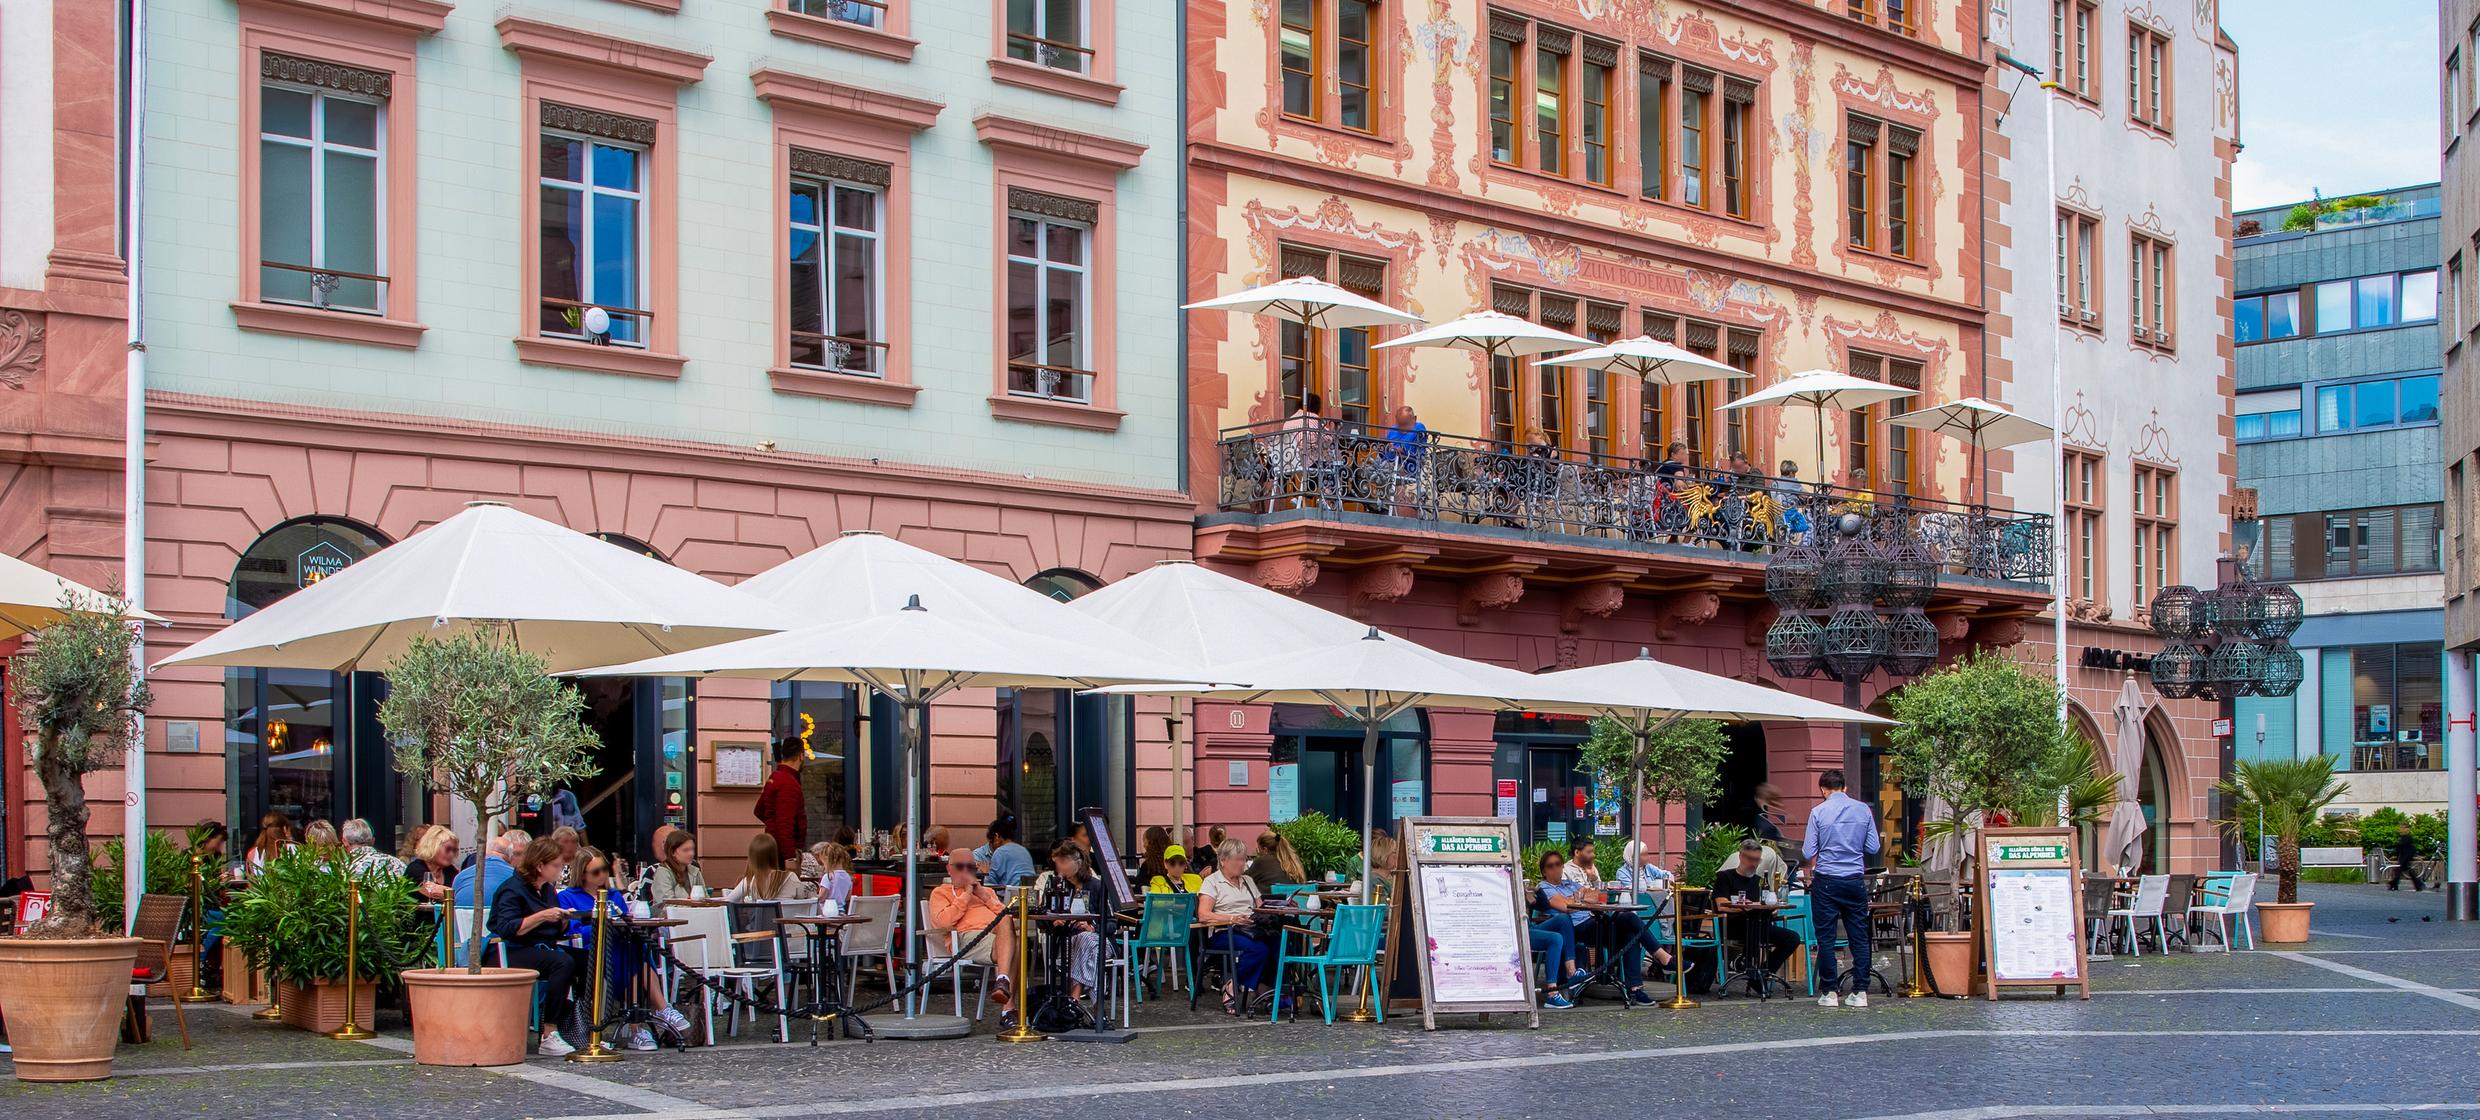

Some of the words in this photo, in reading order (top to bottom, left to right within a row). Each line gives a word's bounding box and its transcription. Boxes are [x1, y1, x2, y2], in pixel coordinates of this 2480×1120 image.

[1582, 261, 1615, 281] ZUM
[1620, 268, 1685, 296] BODERAM
[309, 555, 343, 566] WILMA
[2080, 647, 2122, 668] ADAC
[1233, 714, 1242, 725] 11
[1441, 843, 1455, 851] DAS
[1456, 843, 1493, 851] ALPENBIER
